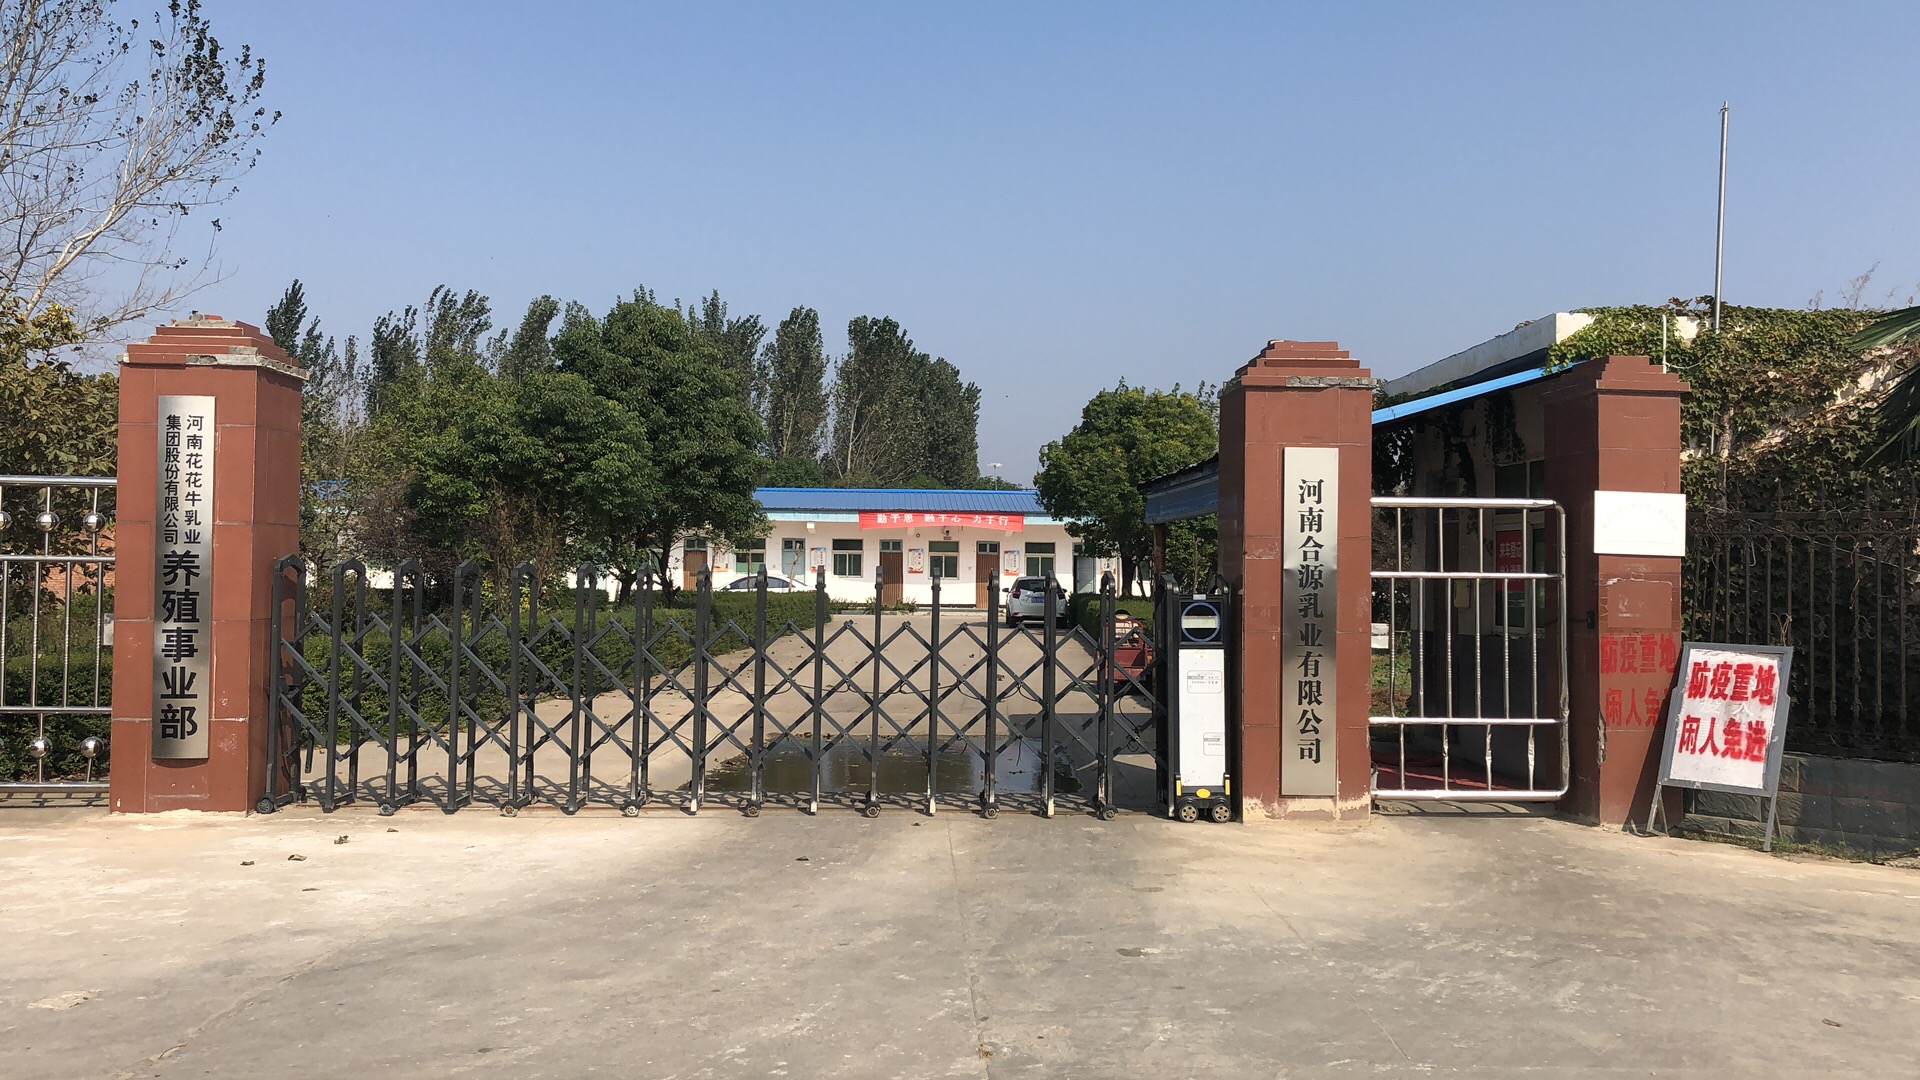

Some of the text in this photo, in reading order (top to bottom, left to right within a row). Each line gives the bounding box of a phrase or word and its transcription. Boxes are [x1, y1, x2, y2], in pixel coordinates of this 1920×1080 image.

[163, 414, 182, 545] 集团股份有限公司
[184, 414, 204, 545] 河南花花牛乳业
[877, 513, 1010, 526] 勤于思 融于心 力于行
[160, 549, 201, 740] 养殖事业部
[1297, 478, 1325, 764] 河南合源乳业有限公司
[1601, 633, 1677, 674] 防疫重地
[1606, 687, 1669, 727] 闲人免
[1687, 660, 1776, 706] 防疫重地
